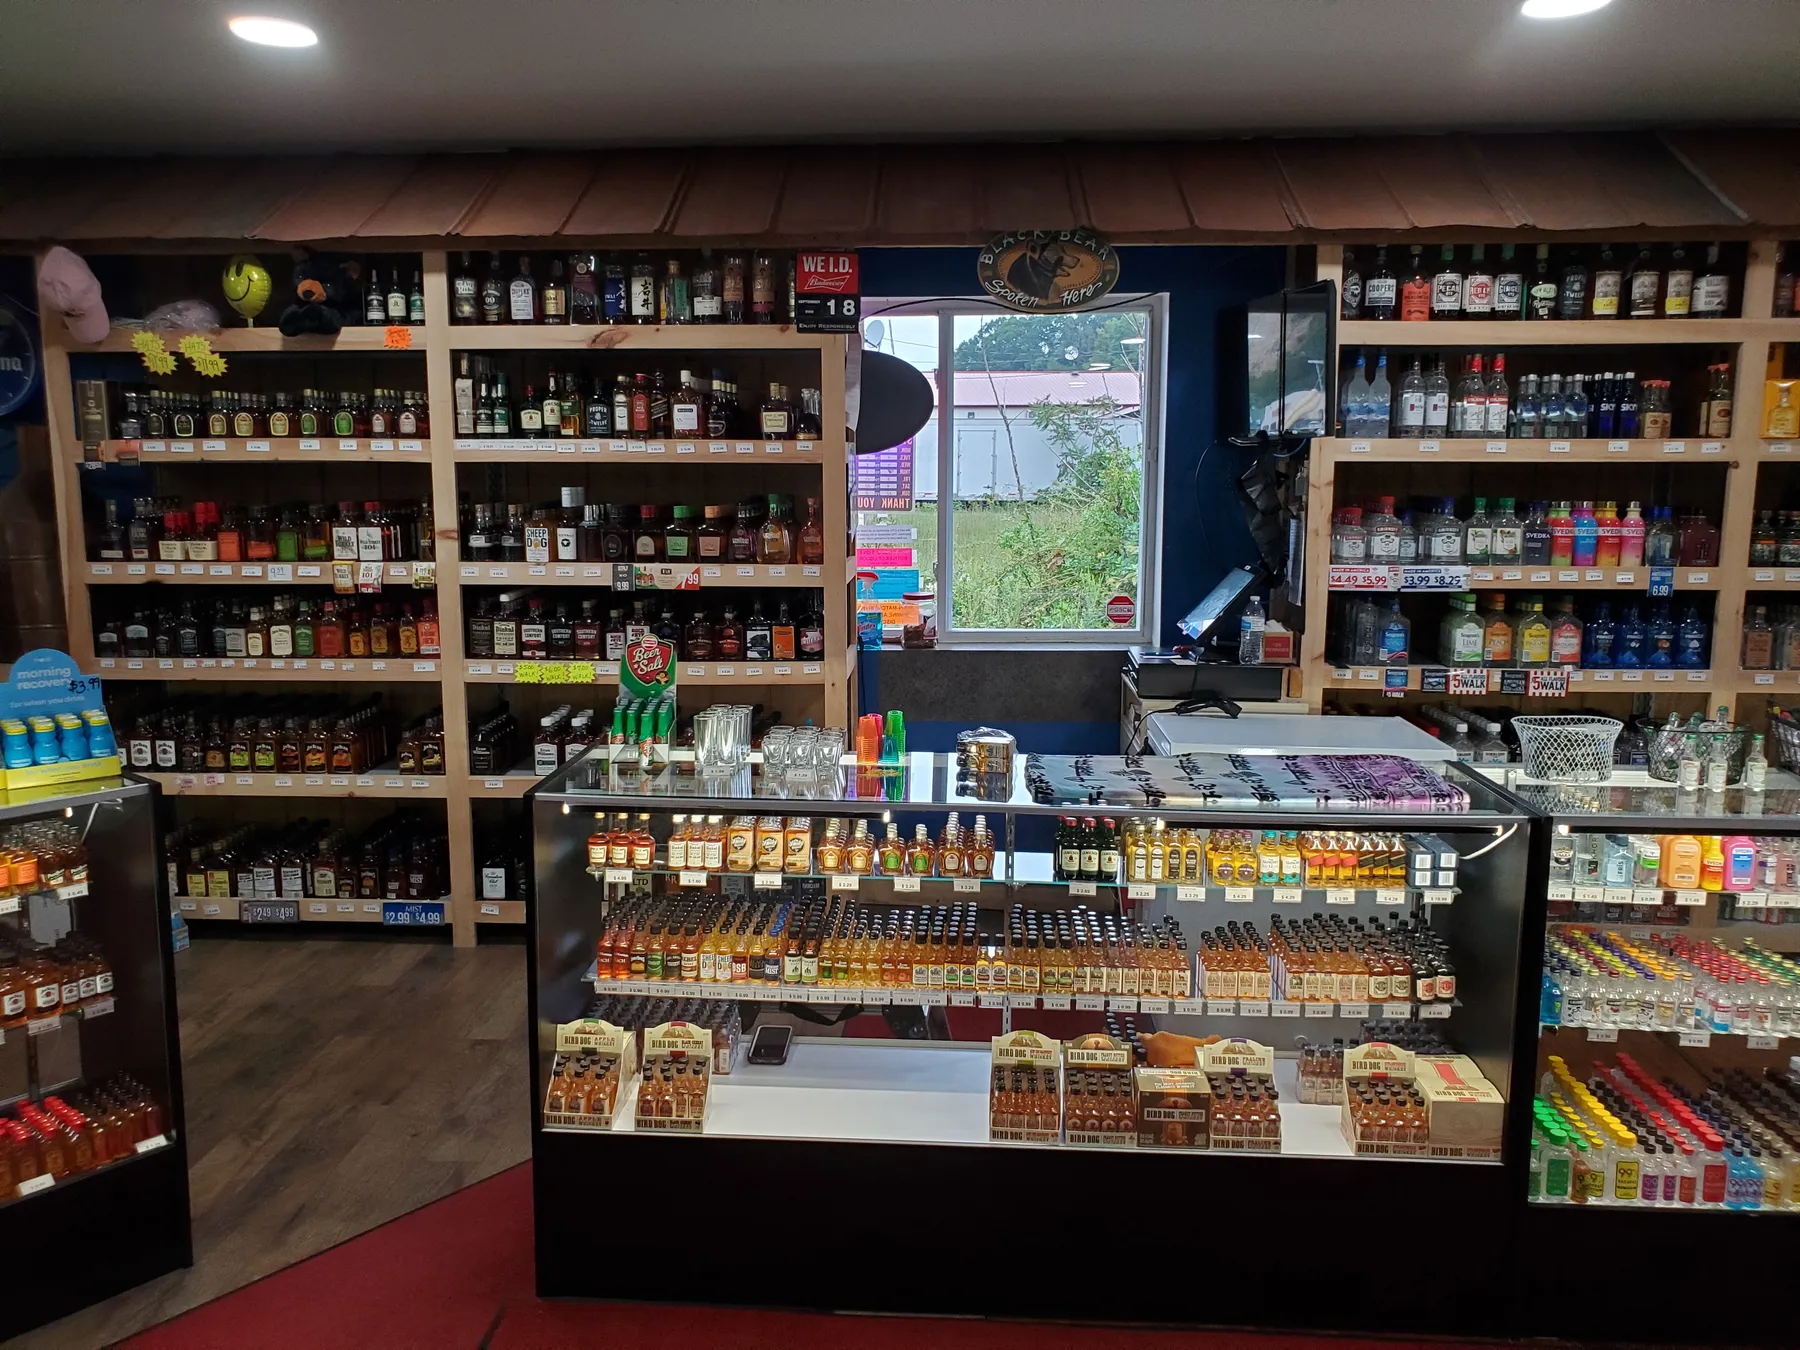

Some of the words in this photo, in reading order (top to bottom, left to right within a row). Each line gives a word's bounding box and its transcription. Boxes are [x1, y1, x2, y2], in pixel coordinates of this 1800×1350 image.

[980, 230, 1044, 265] BLACK
[1060, 231, 1110, 261] BEAR
[803, 256, 826, 273] WE
[829, 256, 853, 273] I.D.
[809, 278, 844, 287] Budweiser
[985, 279, 1039, 307] Spoken
[1060, 282, 1102, 307] Here
[184, 341, 206, 353] HATS
[526, 528, 547, 538] SHEEP
[1525, 531, 1551, 540] SVEDKA
[1362, 575, 1387, 585] $5.99
[1404, 575, 1430, 585] $3.99
[1434, 575, 1461, 585] $8.29
[1652, 585, 1669, 596] 6.99
[1462, 638, 1478, 647] LIME
[633, 646, 661, 663] Beer
[638, 656, 664, 675] Salt
[16, 667, 72, 680] morning
[16, 679, 73, 691] recovery
[68, 677, 100, 694] $3.99
[1451, 674, 1461, 689] $5
[1461, 679, 1486, 689] WALK
[1531, 675, 1540, 690] $5
[1540, 680, 1565, 691] WALK
[47, 697, 63, 705] you
[64, 694, 86, 703] drink
[633, 878, 649, 886] LTD
[385, 912, 410, 924] $2.99
[415, 912, 440, 924] $4.99
[564, 1036, 579, 1045] BIRD
[579, 1036, 591, 1045] DOG
[652, 1039, 666, 1048] BIRD
[667, 1040, 678, 1048] DOG
[999, 1048, 1013, 1057] BIRD
[1014, 1048, 1027, 1058] DOG
[1070, 1051, 1085, 1060] BIRD
[1086, 1051, 1098, 1061] DOG
[1211, 1056, 1227, 1065] BIRD
[1227, 1056, 1240, 1065] DOG
[1352, 1061, 1367, 1069] BIRD
[1368, 1061, 1381, 1070] DOG
[637, 1120, 653, 1128] BIRD
[654, 1120, 667, 1128] DOG
[992, 1130, 1009, 1139] BIRD
[1009, 1131, 1023, 1140] DOG
[1070, 1134, 1086, 1143] BIRD
[1087, 1134, 1100, 1143] DOG
[1213, 1139, 1230, 1148] BIRD
[1231, 1140, 1244, 1149] DOG
[1357, 1144, 1374, 1153] BIRD
[1375, 1144, 1389, 1153] DOG
[1431, 1146, 1448, 1156] BIRD
[1449, 1147, 1462, 1156] DOG
